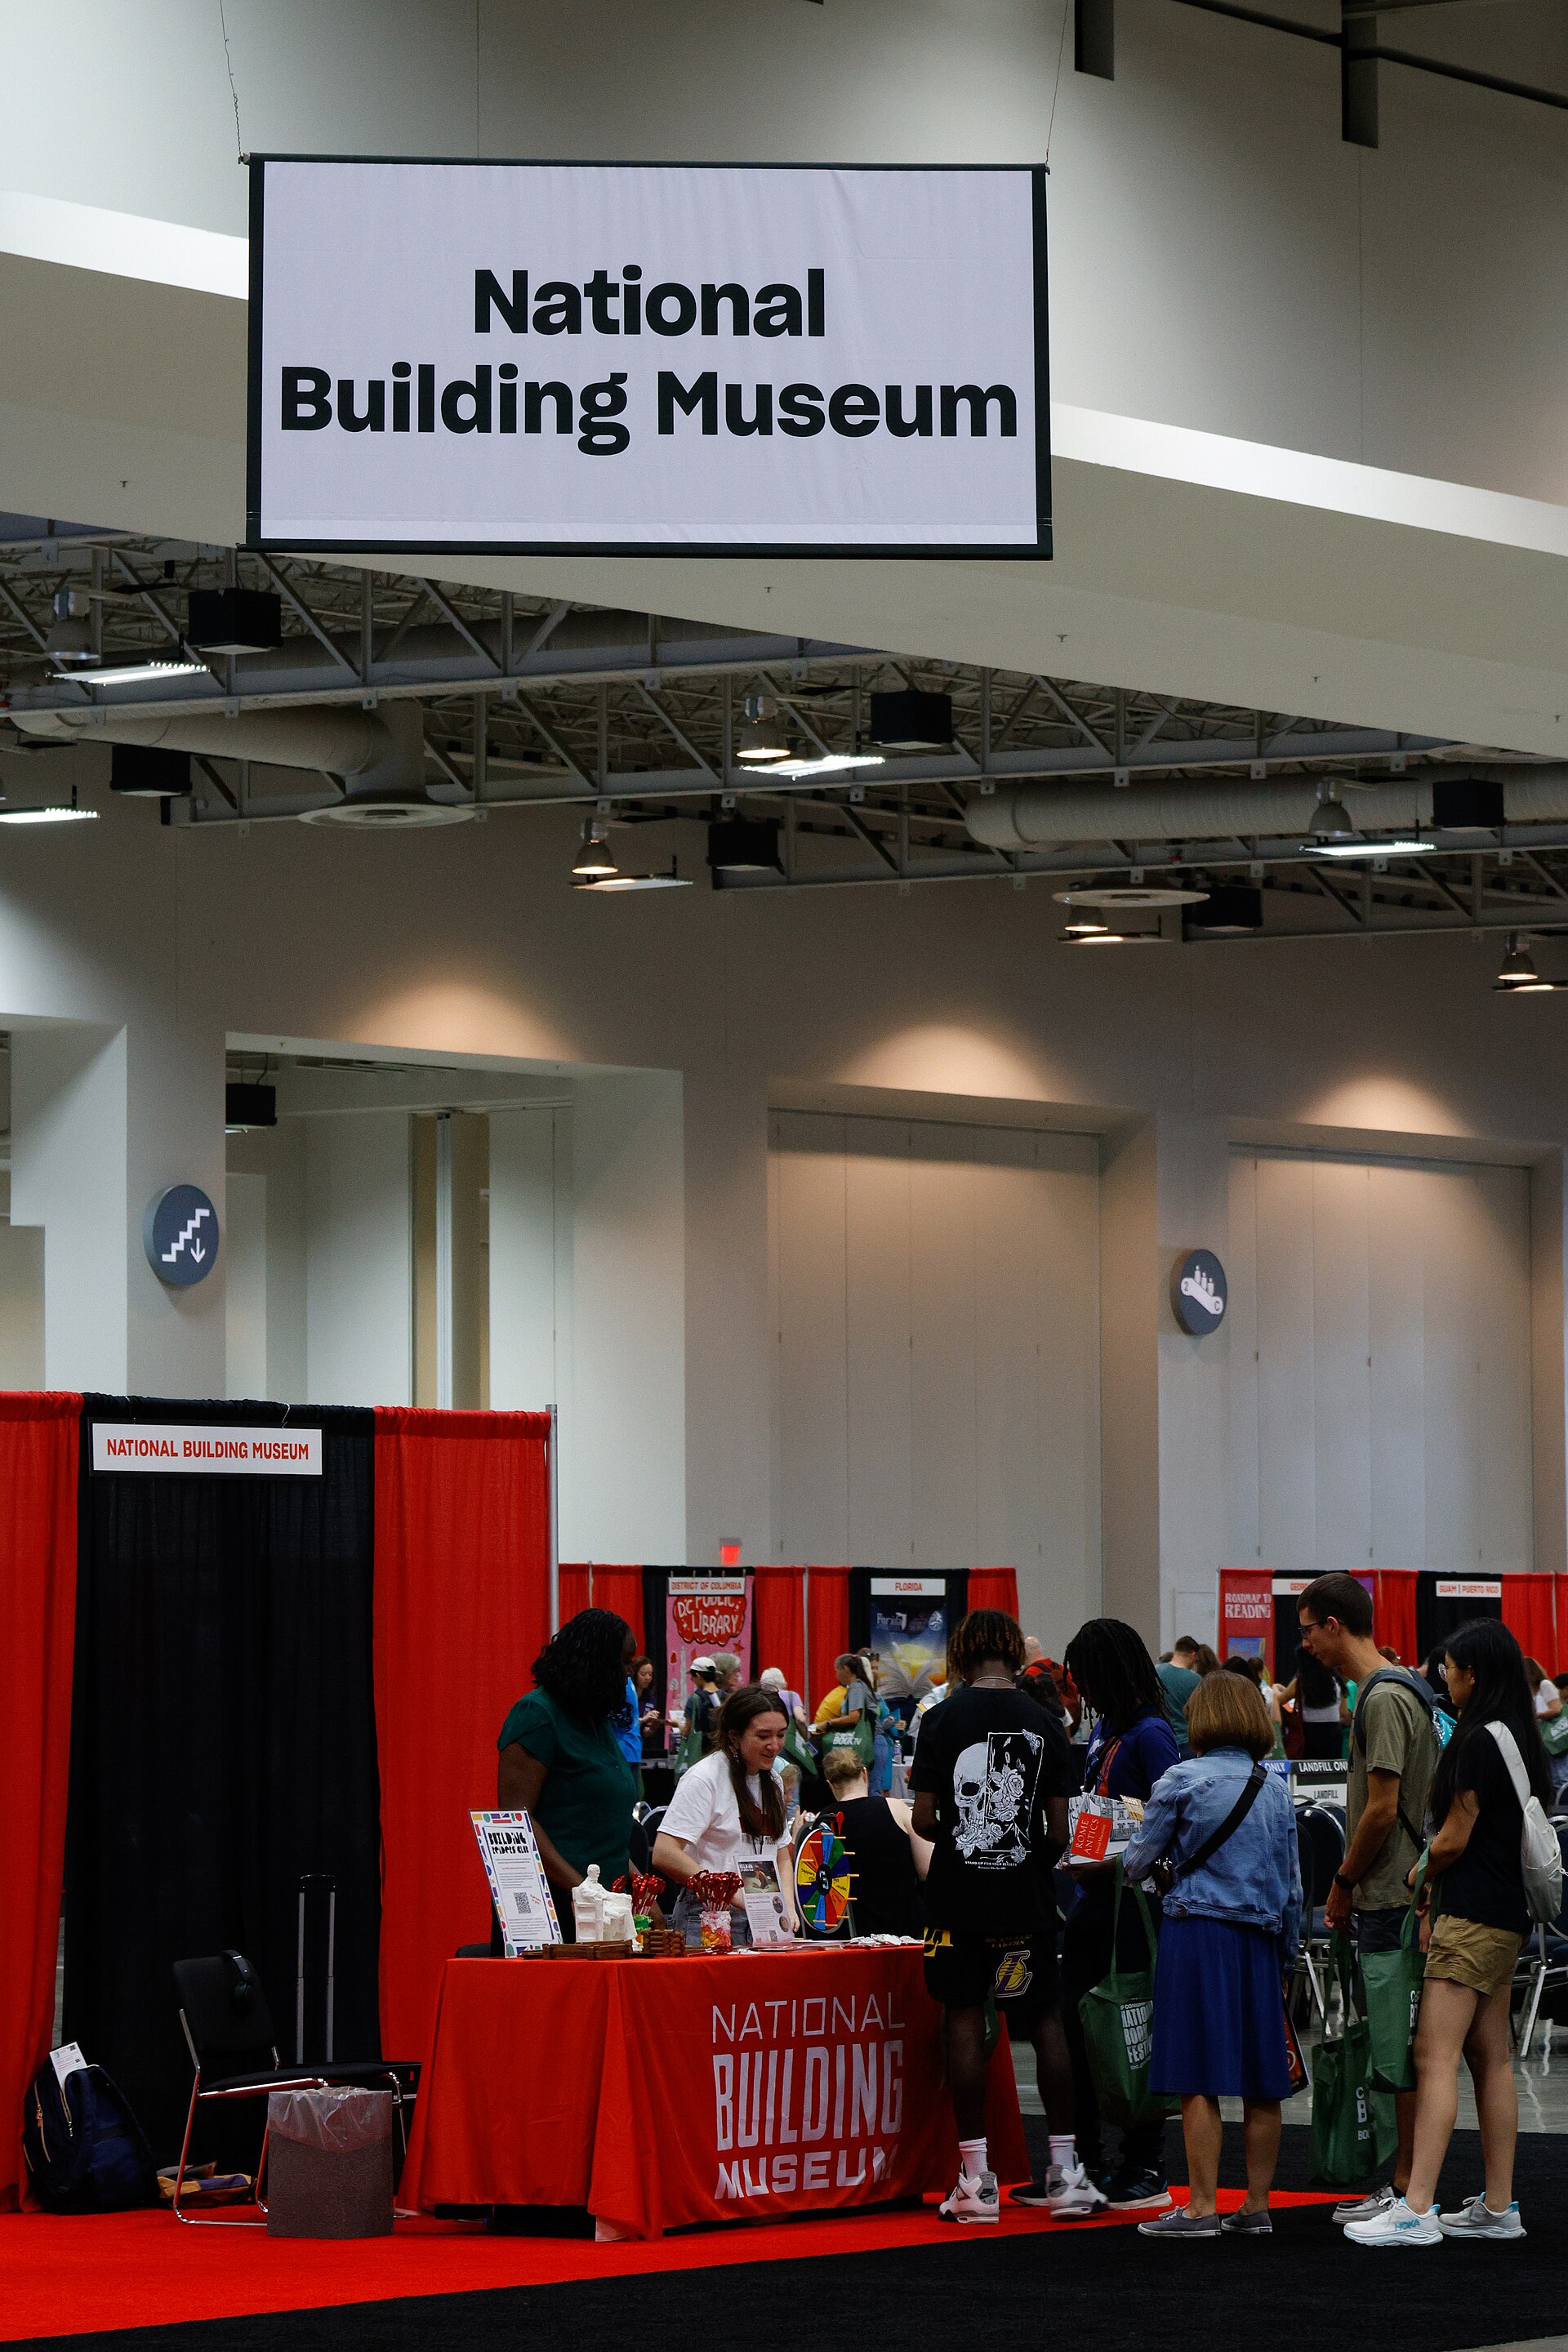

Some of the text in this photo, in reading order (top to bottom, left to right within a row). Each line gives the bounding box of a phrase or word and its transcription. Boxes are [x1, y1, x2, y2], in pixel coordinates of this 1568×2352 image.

[474, 264, 825, 337] National
[281, 361, 1017, 456] Building Museum
[107, 1439, 309, 1460] NATIONAL BUILDING MUSEUM
[671, 1581, 742, 1590] DISTRICT OF COLUMBIA
[894, 1582, 923, 1592] FLORIDA
[1440, 1585, 1499, 1594] GUAM PUERTO RICO
[1225, 1593, 1272, 1604] ROADMAP TO
[1225, 1604, 1271, 1619] READING
[691, 1610, 739, 1637] LIBRARY
[1265, 1762, 1286, 1772] ONLY
[1298, 1761, 1333, 1772] LANDFILL
[1313, 1789, 1339, 1799] LANDFILL
[1075, 1820, 1089, 1849] ROME
[1085, 1818, 1099, 1855] ANTICS
[712, 1992, 906, 2043] NATIONAL
[712, 2039, 903, 2151] BUILDING
[714, 2144, 899, 2200] MUSEUM
[1394, 2218, 1421, 2231] HOKA
